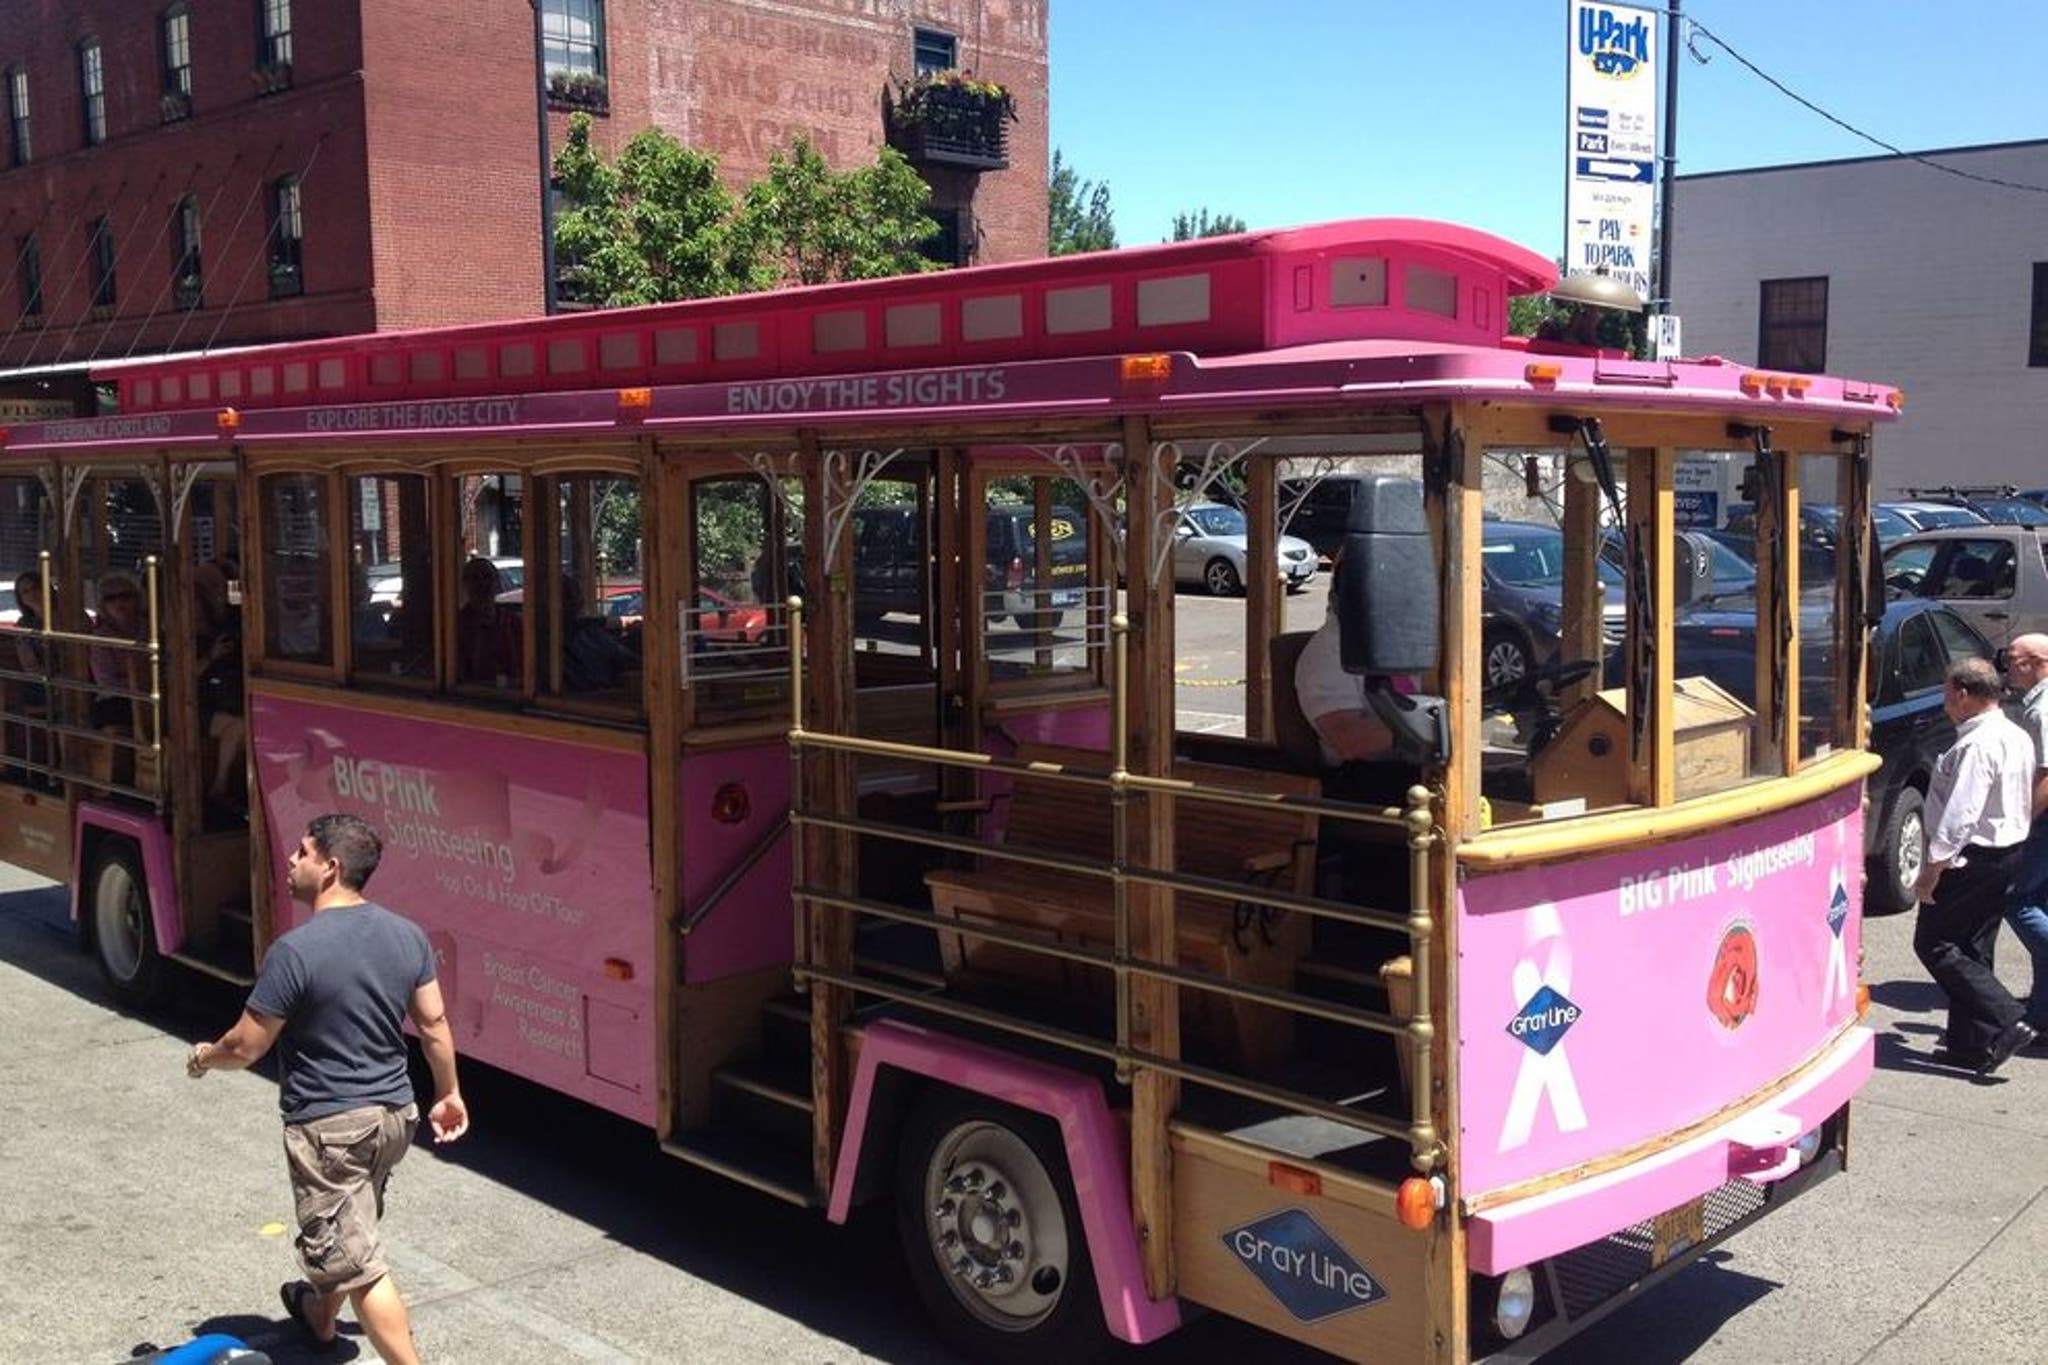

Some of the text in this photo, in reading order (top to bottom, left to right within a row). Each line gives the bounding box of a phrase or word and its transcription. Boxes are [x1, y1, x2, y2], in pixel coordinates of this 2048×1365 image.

[1599, 218, 1621, 241] PAY
[727, 369, 1005, 413] ENJOY THE SIGHTS
[306, 400, 518, 431] EXPLORE THE ROSE CITY
[333, 755, 440, 816] BIG Pink
[384, 808, 516, 882] Sightseeing
[1619, 832, 1816, 917] BIG Pink Sightseeing
[528, 966, 578, 1000] Cancer
[493, 986, 567, 1025] Awareness
[517, 1017, 583, 1061] Research
